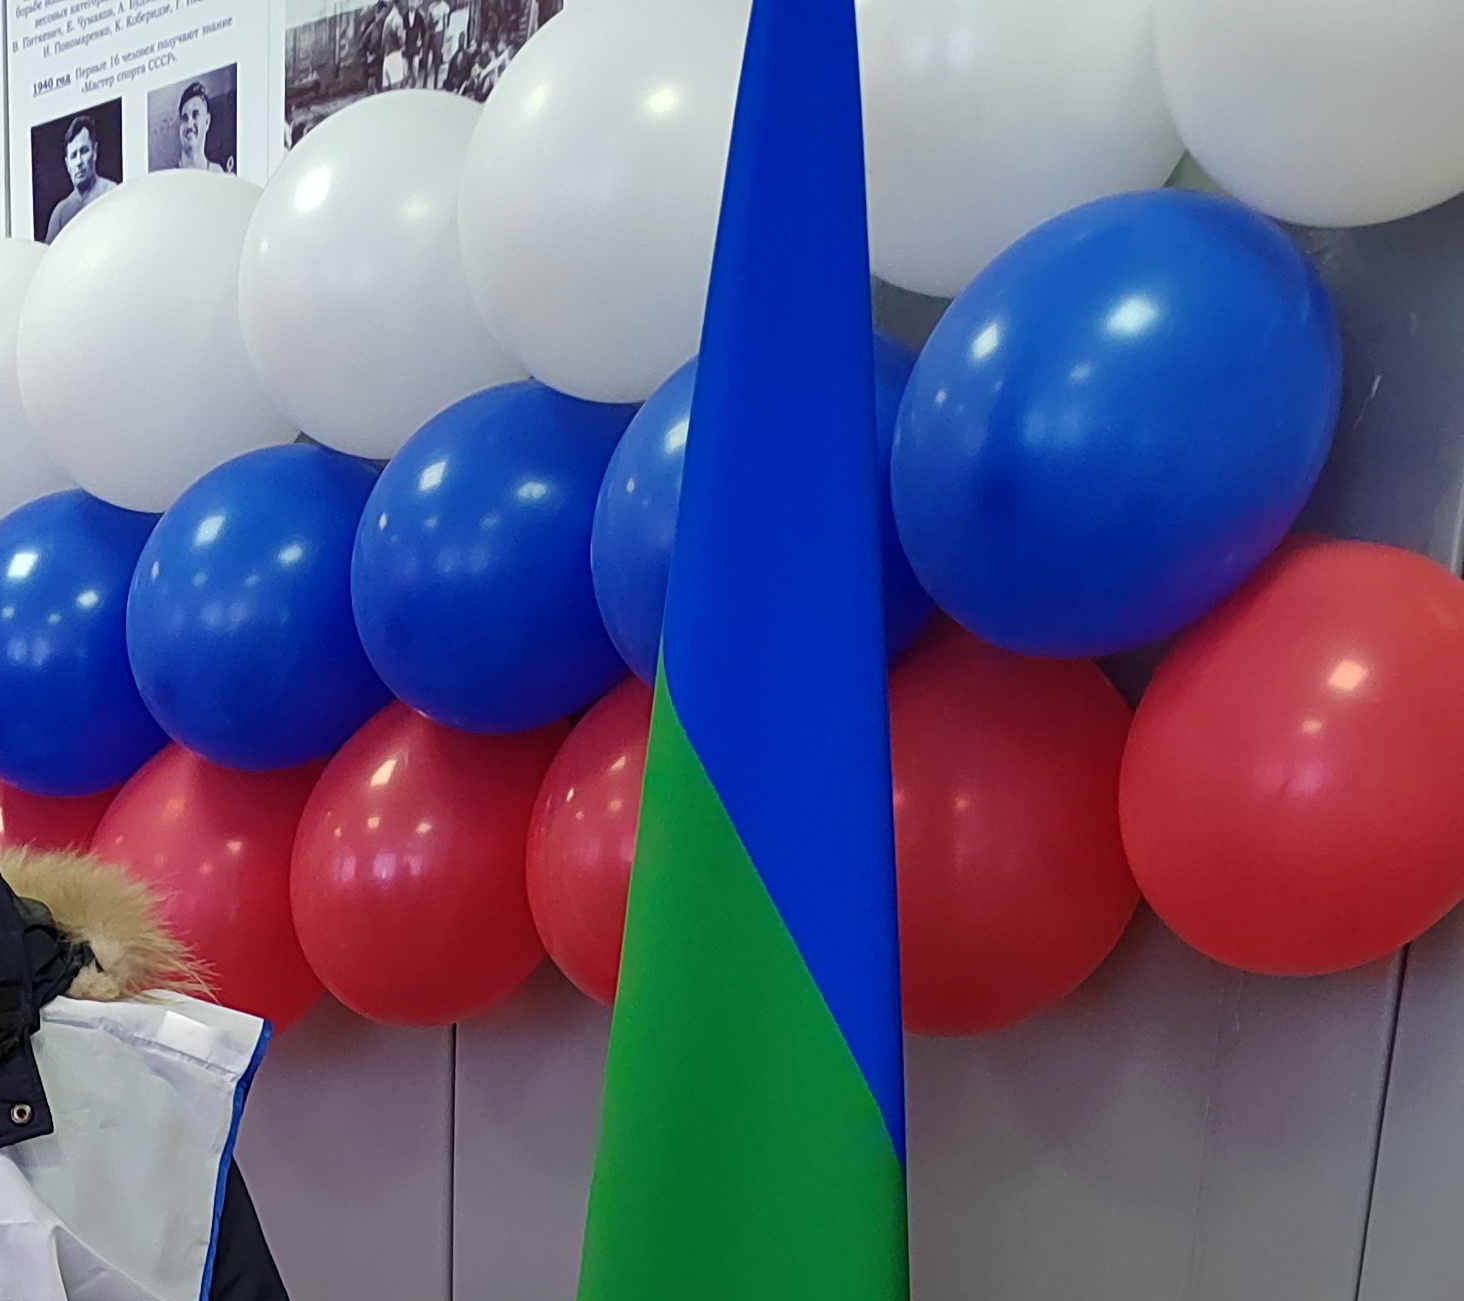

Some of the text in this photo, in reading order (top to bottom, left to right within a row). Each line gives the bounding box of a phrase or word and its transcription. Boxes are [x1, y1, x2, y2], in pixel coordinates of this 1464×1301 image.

[33, 78, 55, 97] 1940
[54, 74, 71, 90] год
[76, 61, 107, 80] Первые
[110, 53, 120, 68] 16
[122, 44, 155, 62] человек
[158, 28, 199, 51] получают
[117, 64, 145, 82] спорта
